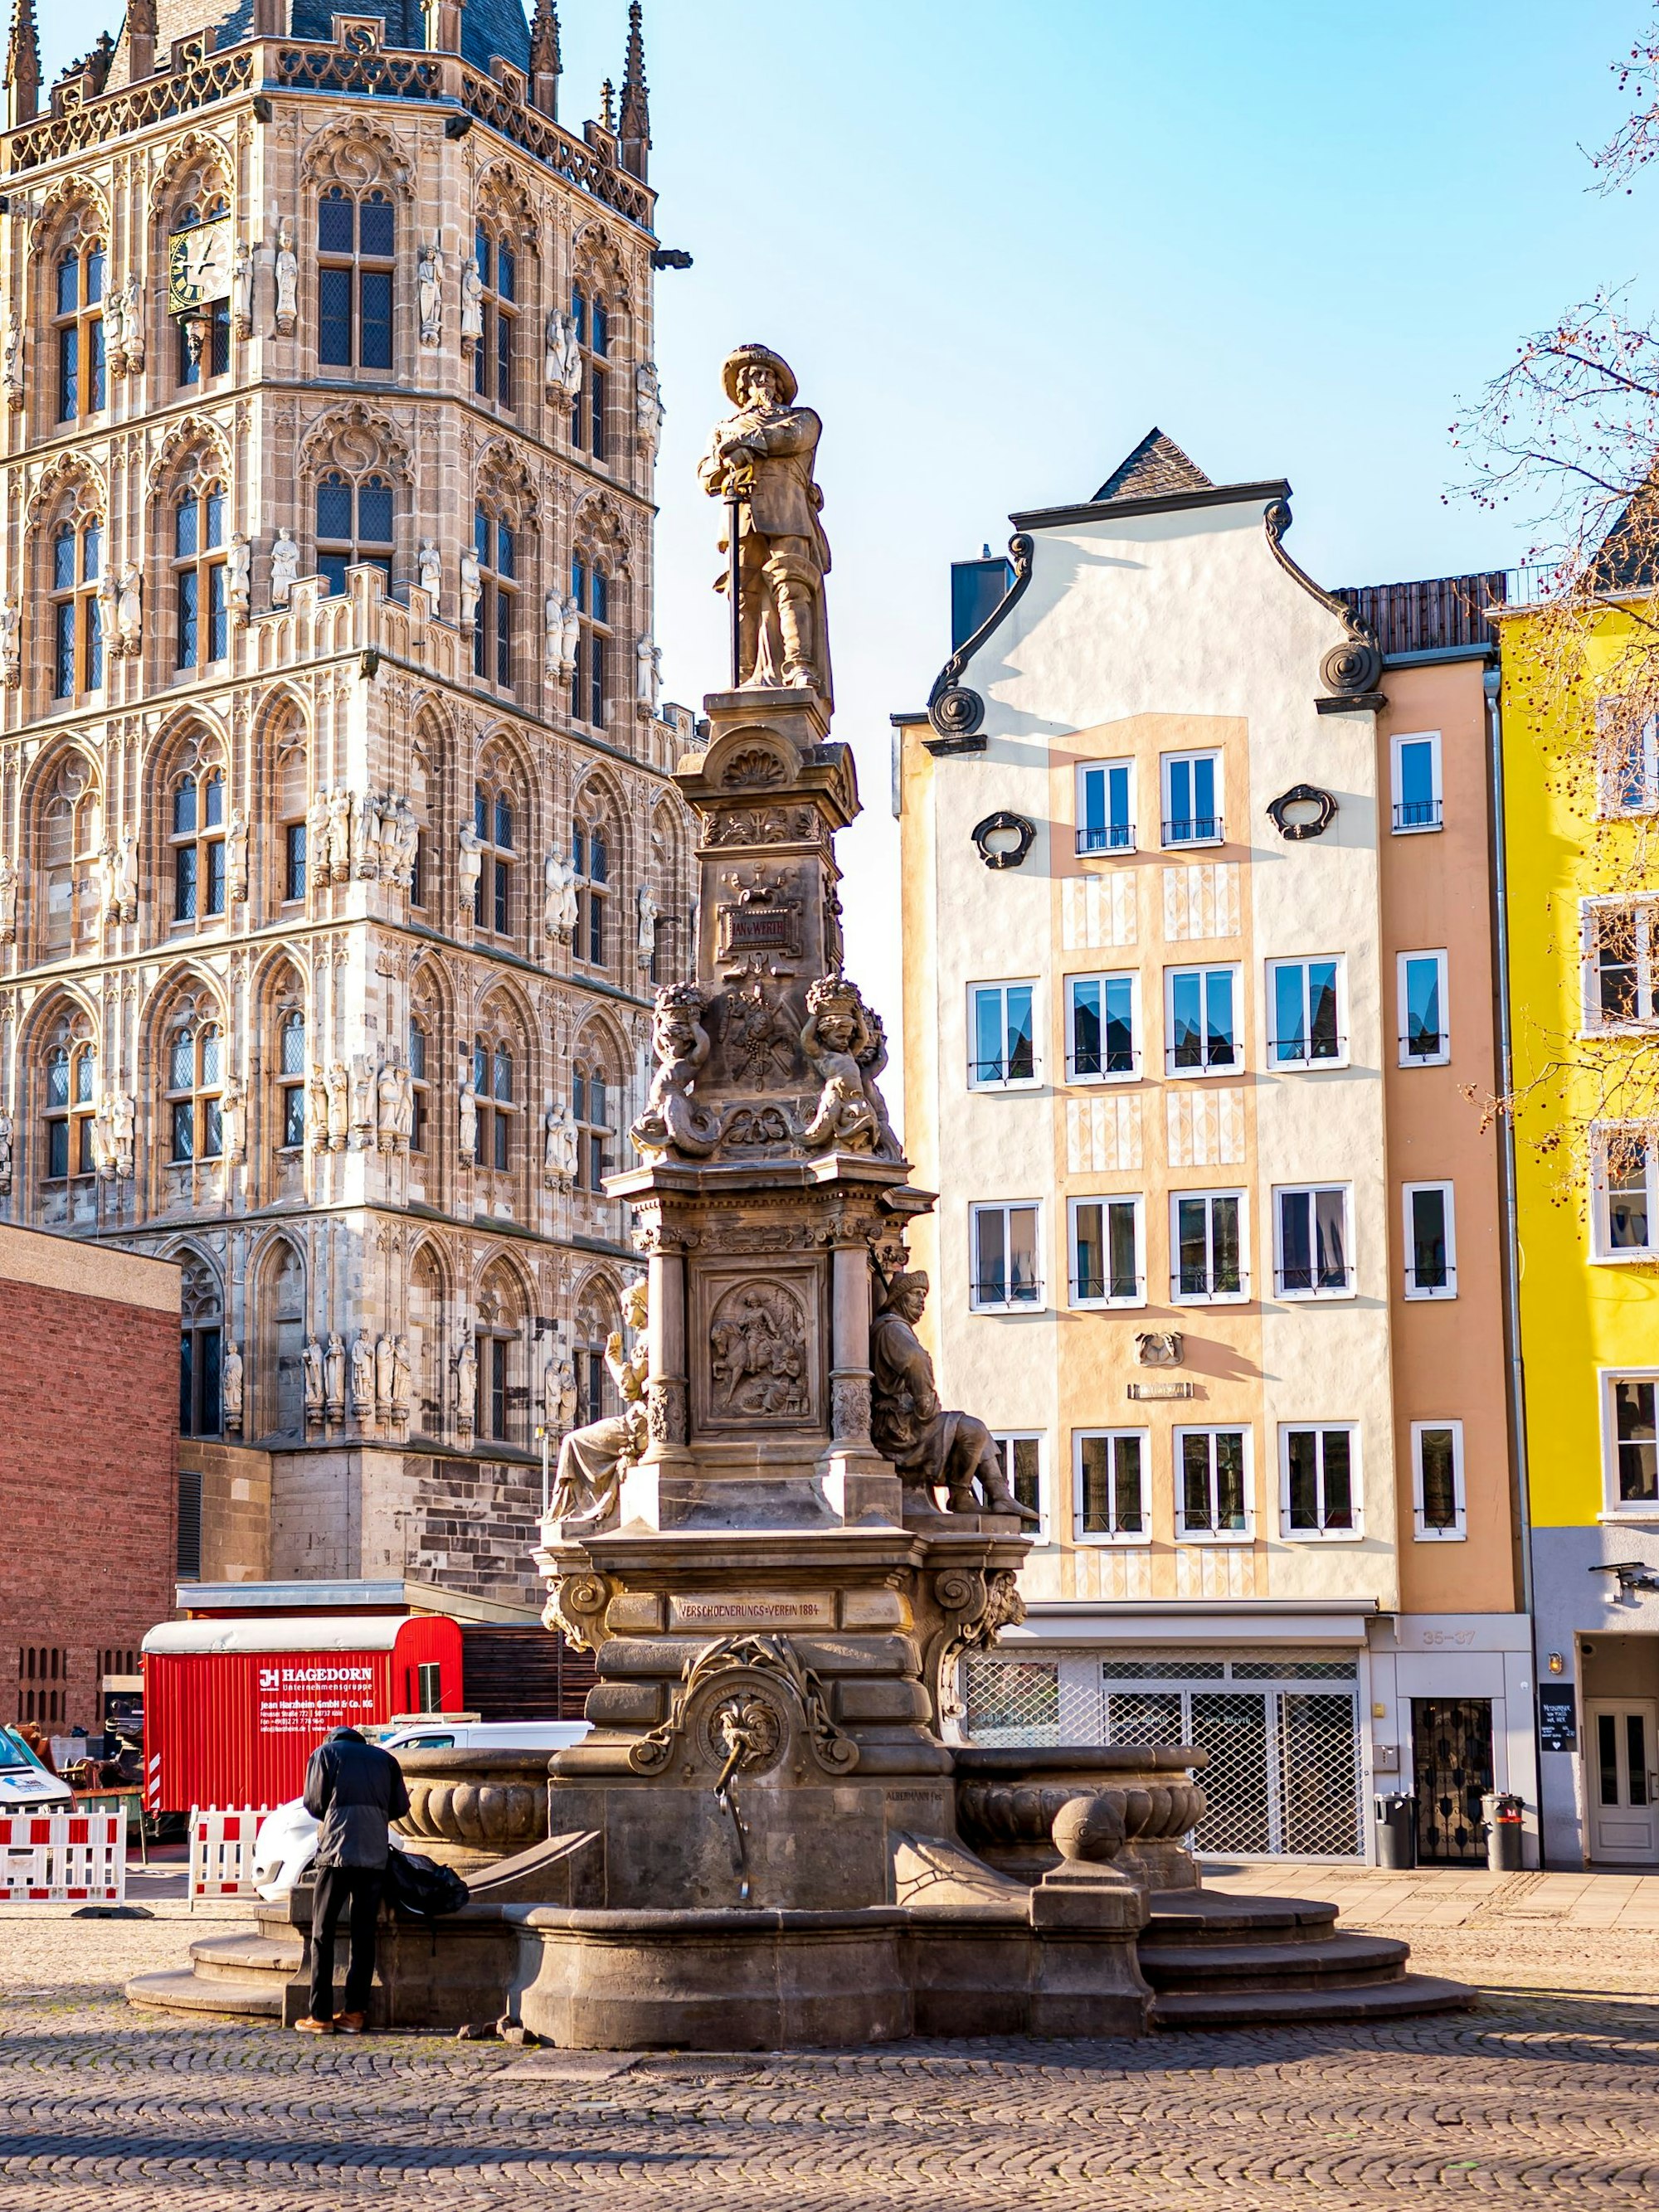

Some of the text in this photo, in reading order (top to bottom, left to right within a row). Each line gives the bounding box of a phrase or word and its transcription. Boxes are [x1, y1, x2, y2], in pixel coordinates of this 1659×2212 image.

[753, 921, 784, 936] WERTH
[800, 1604, 820, 1616] 1884
[1423, 1630, 1476, 1646] 35-37
[282, 1668, 372, 1681] HAGEDORN
[283, 1683, 372, 1692] Unternehmensgruppe
[260, 1699, 374, 1710] Jean Harzheim GmbH & Co. KG
